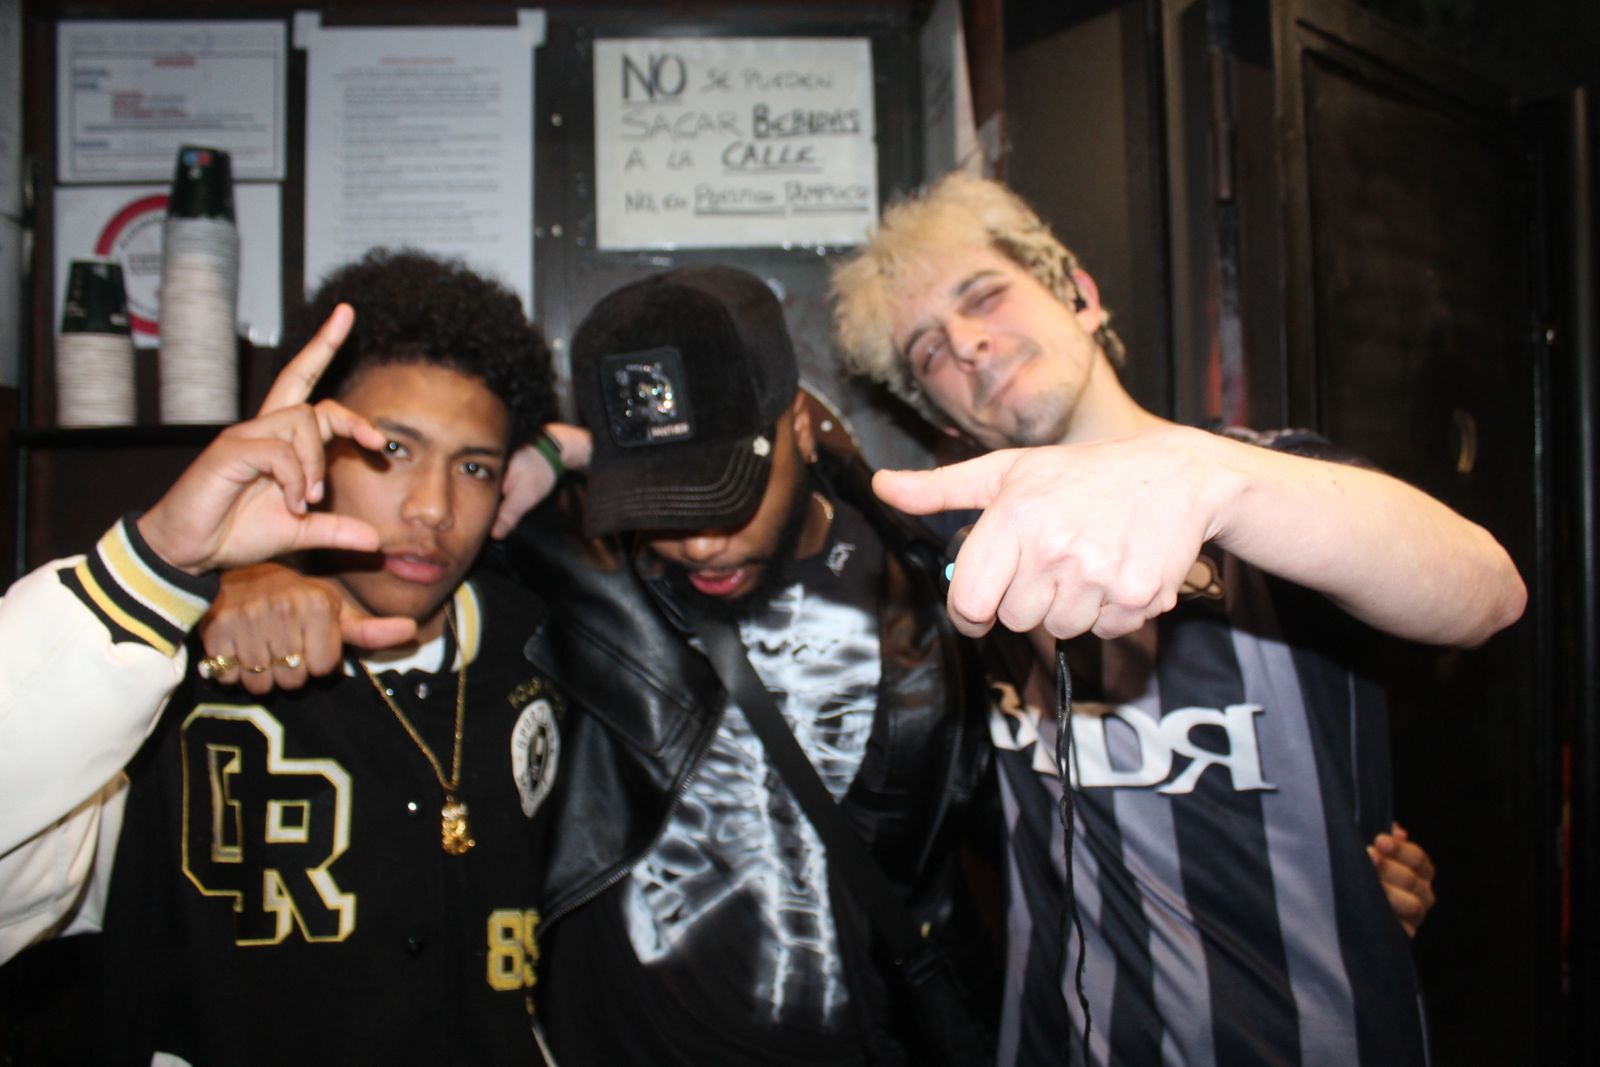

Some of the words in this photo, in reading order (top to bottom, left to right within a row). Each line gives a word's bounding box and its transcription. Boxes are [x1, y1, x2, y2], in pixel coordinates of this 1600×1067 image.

[621, 52, 687, 100] NO
[620, 108, 743, 141] SACAR
[624, 147, 646, 171] A
[722, 141, 816, 167] CALLE
